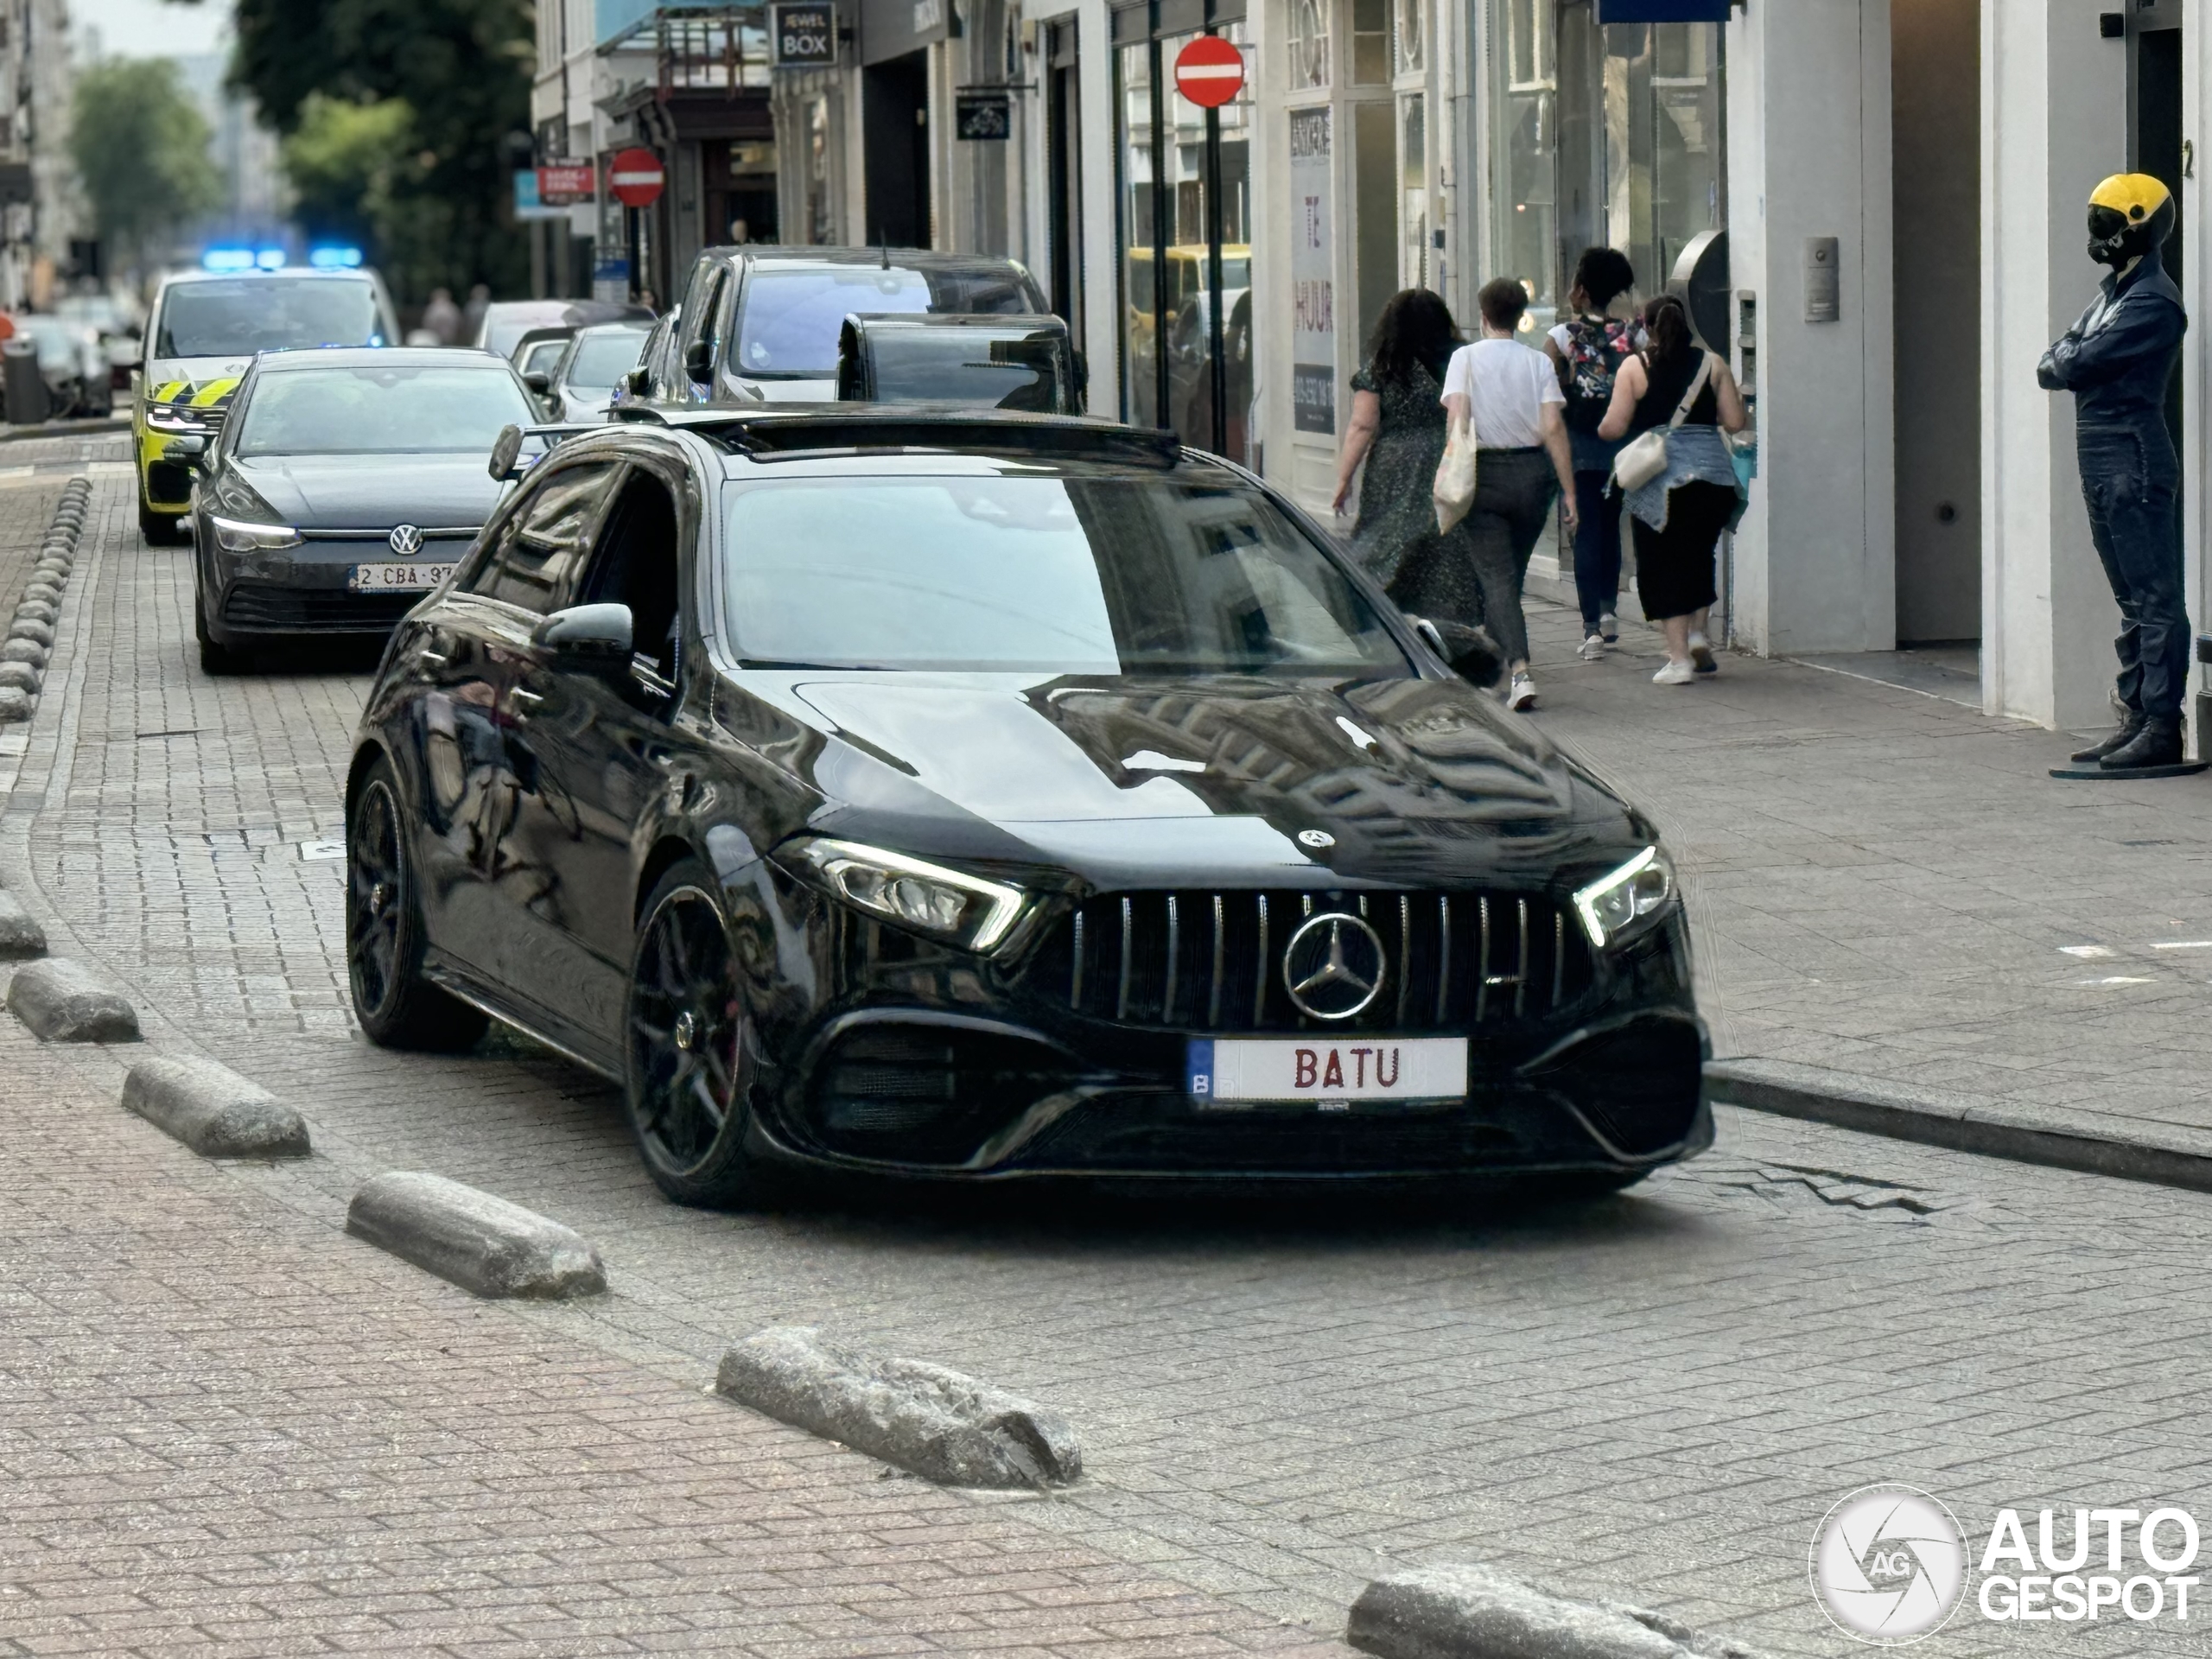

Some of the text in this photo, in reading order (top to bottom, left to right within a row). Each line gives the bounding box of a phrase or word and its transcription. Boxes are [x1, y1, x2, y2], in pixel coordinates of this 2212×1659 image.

[783, 35, 827, 55] BOX
[1305, 196, 1320, 250] TE
[1294, 1048, 1399, 1088] BATU
[1193, 1074, 1209, 1094] B
